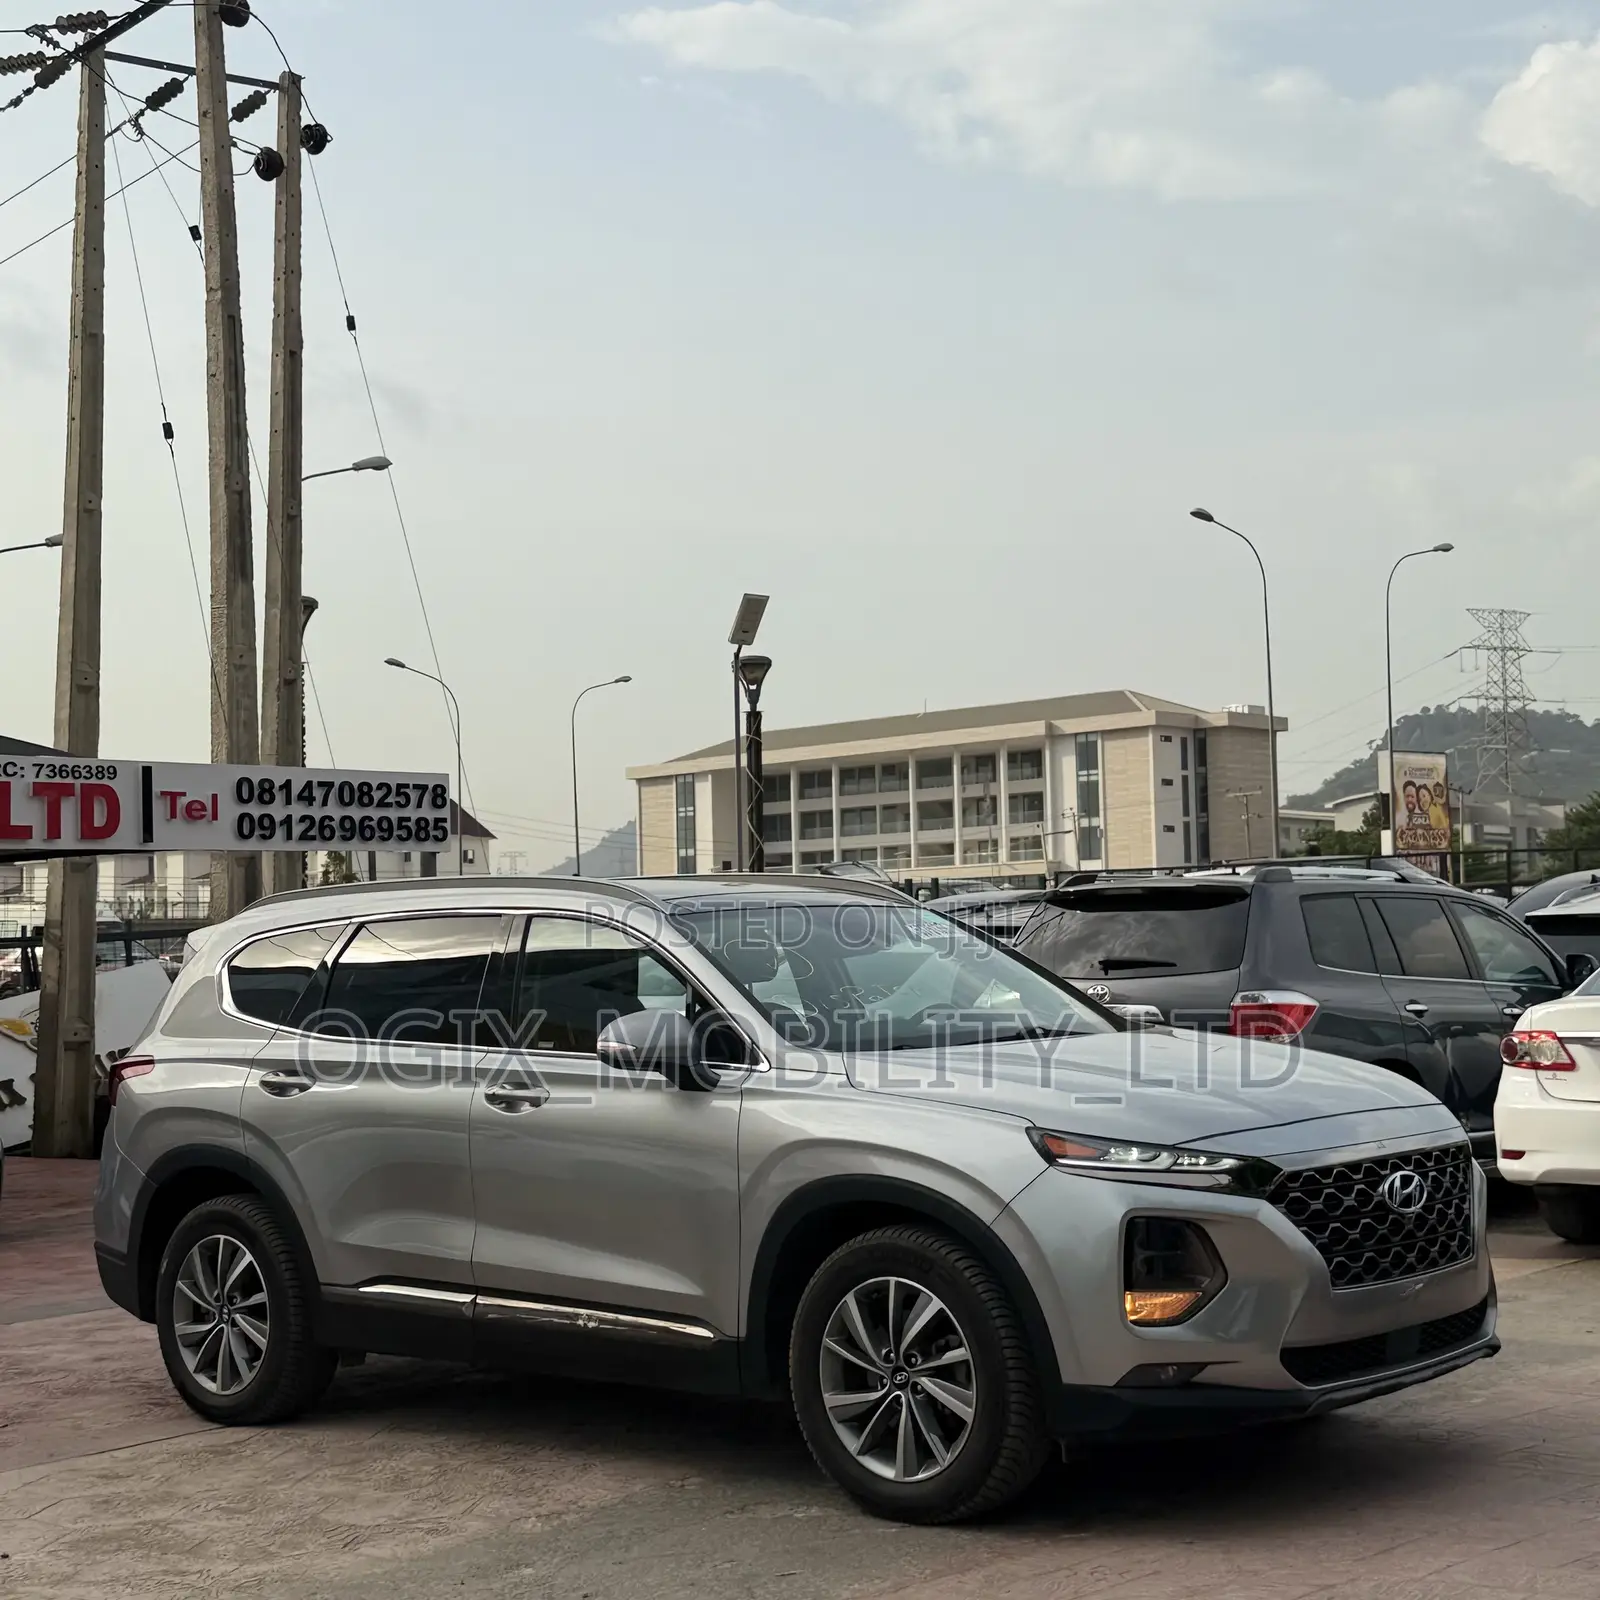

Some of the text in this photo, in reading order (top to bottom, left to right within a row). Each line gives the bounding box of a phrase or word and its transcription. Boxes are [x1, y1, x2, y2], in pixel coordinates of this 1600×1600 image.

[0, 761, 118, 780] C: 7366389
[159, 790, 219, 822] Tel
[235, 776, 448, 809] 08147082578
[0, 781, 121, 840] LTD
[236, 812, 449, 843] 09126969585
